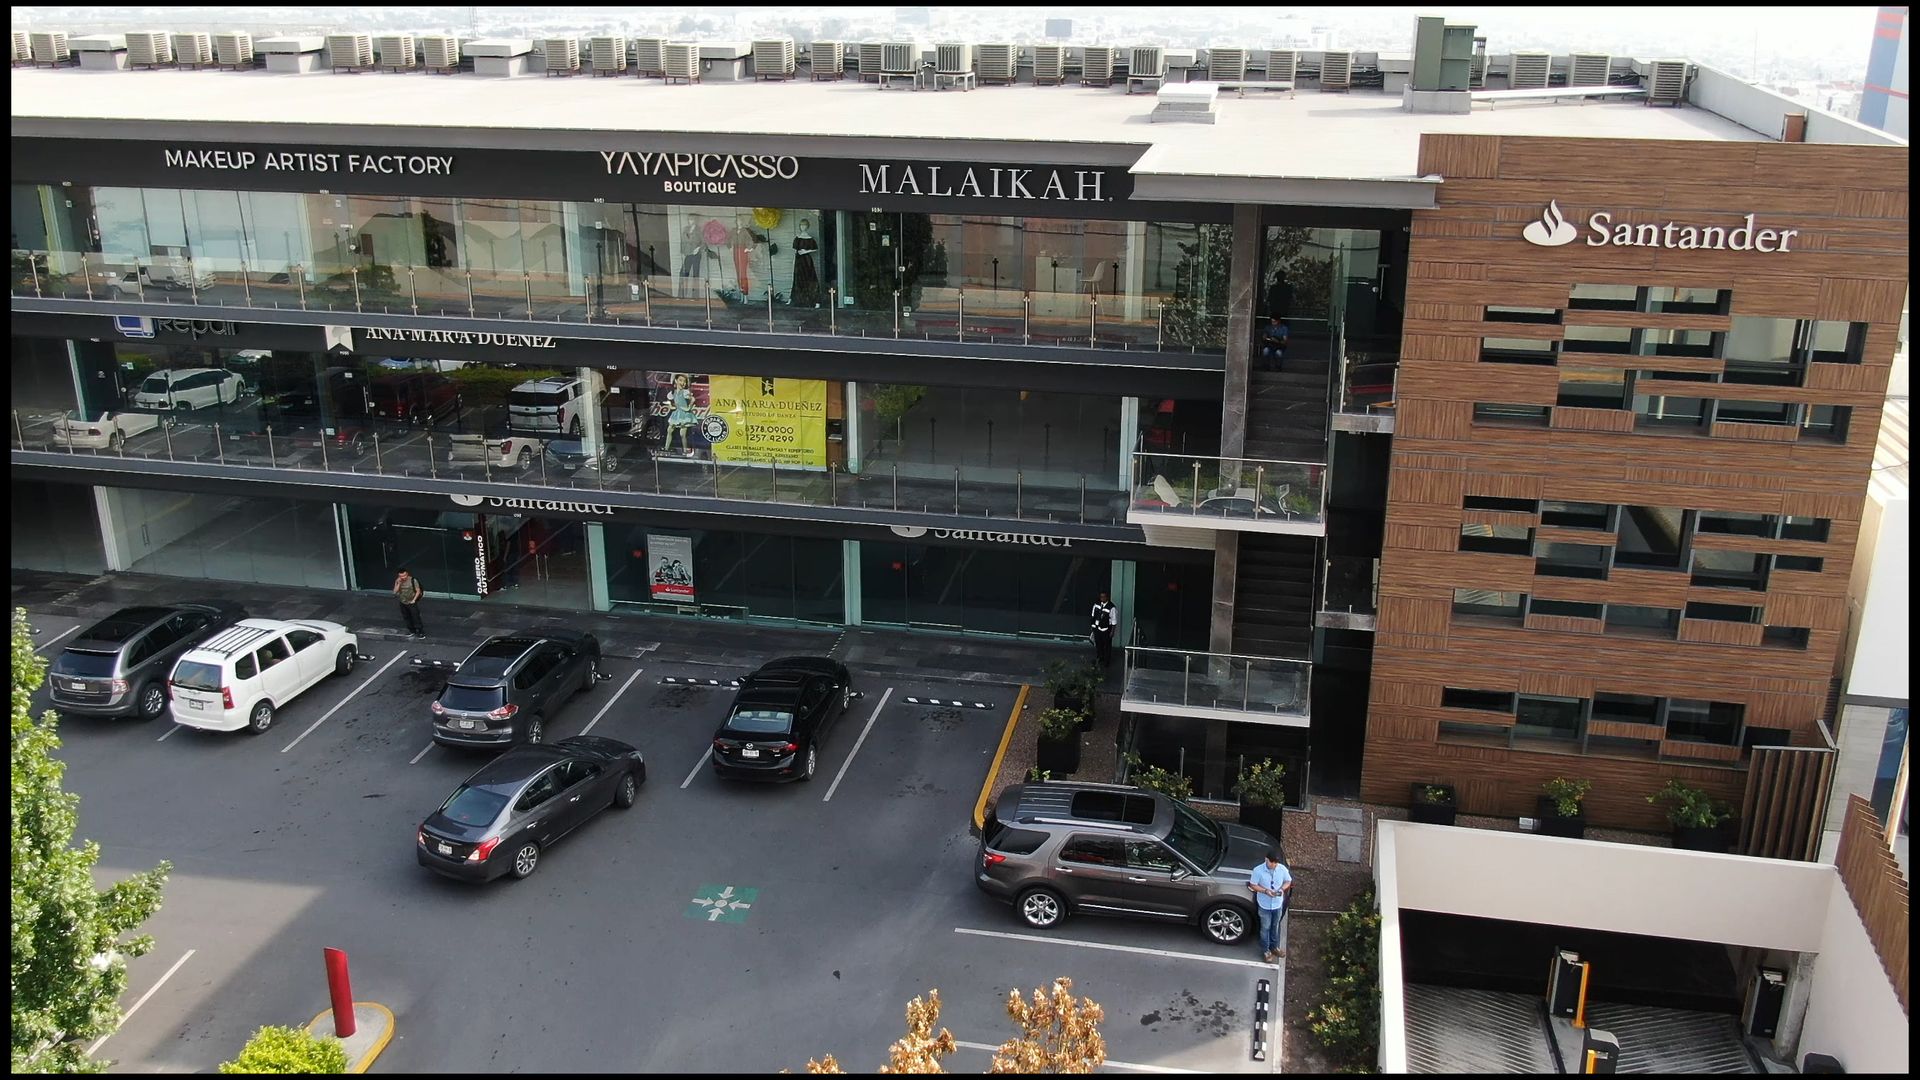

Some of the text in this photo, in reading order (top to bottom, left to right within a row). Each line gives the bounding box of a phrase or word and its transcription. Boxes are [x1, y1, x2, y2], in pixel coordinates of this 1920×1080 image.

[165, 149, 453, 175] MAKEUP ARTIST FACTORY
[600, 151, 799, 179] YAYAPICASSO
[663, 180, 737, 194] BOUTIQUE
[1586, 212, 1798, 253] Santander
[474, 557, 483, 594] CAJERO
